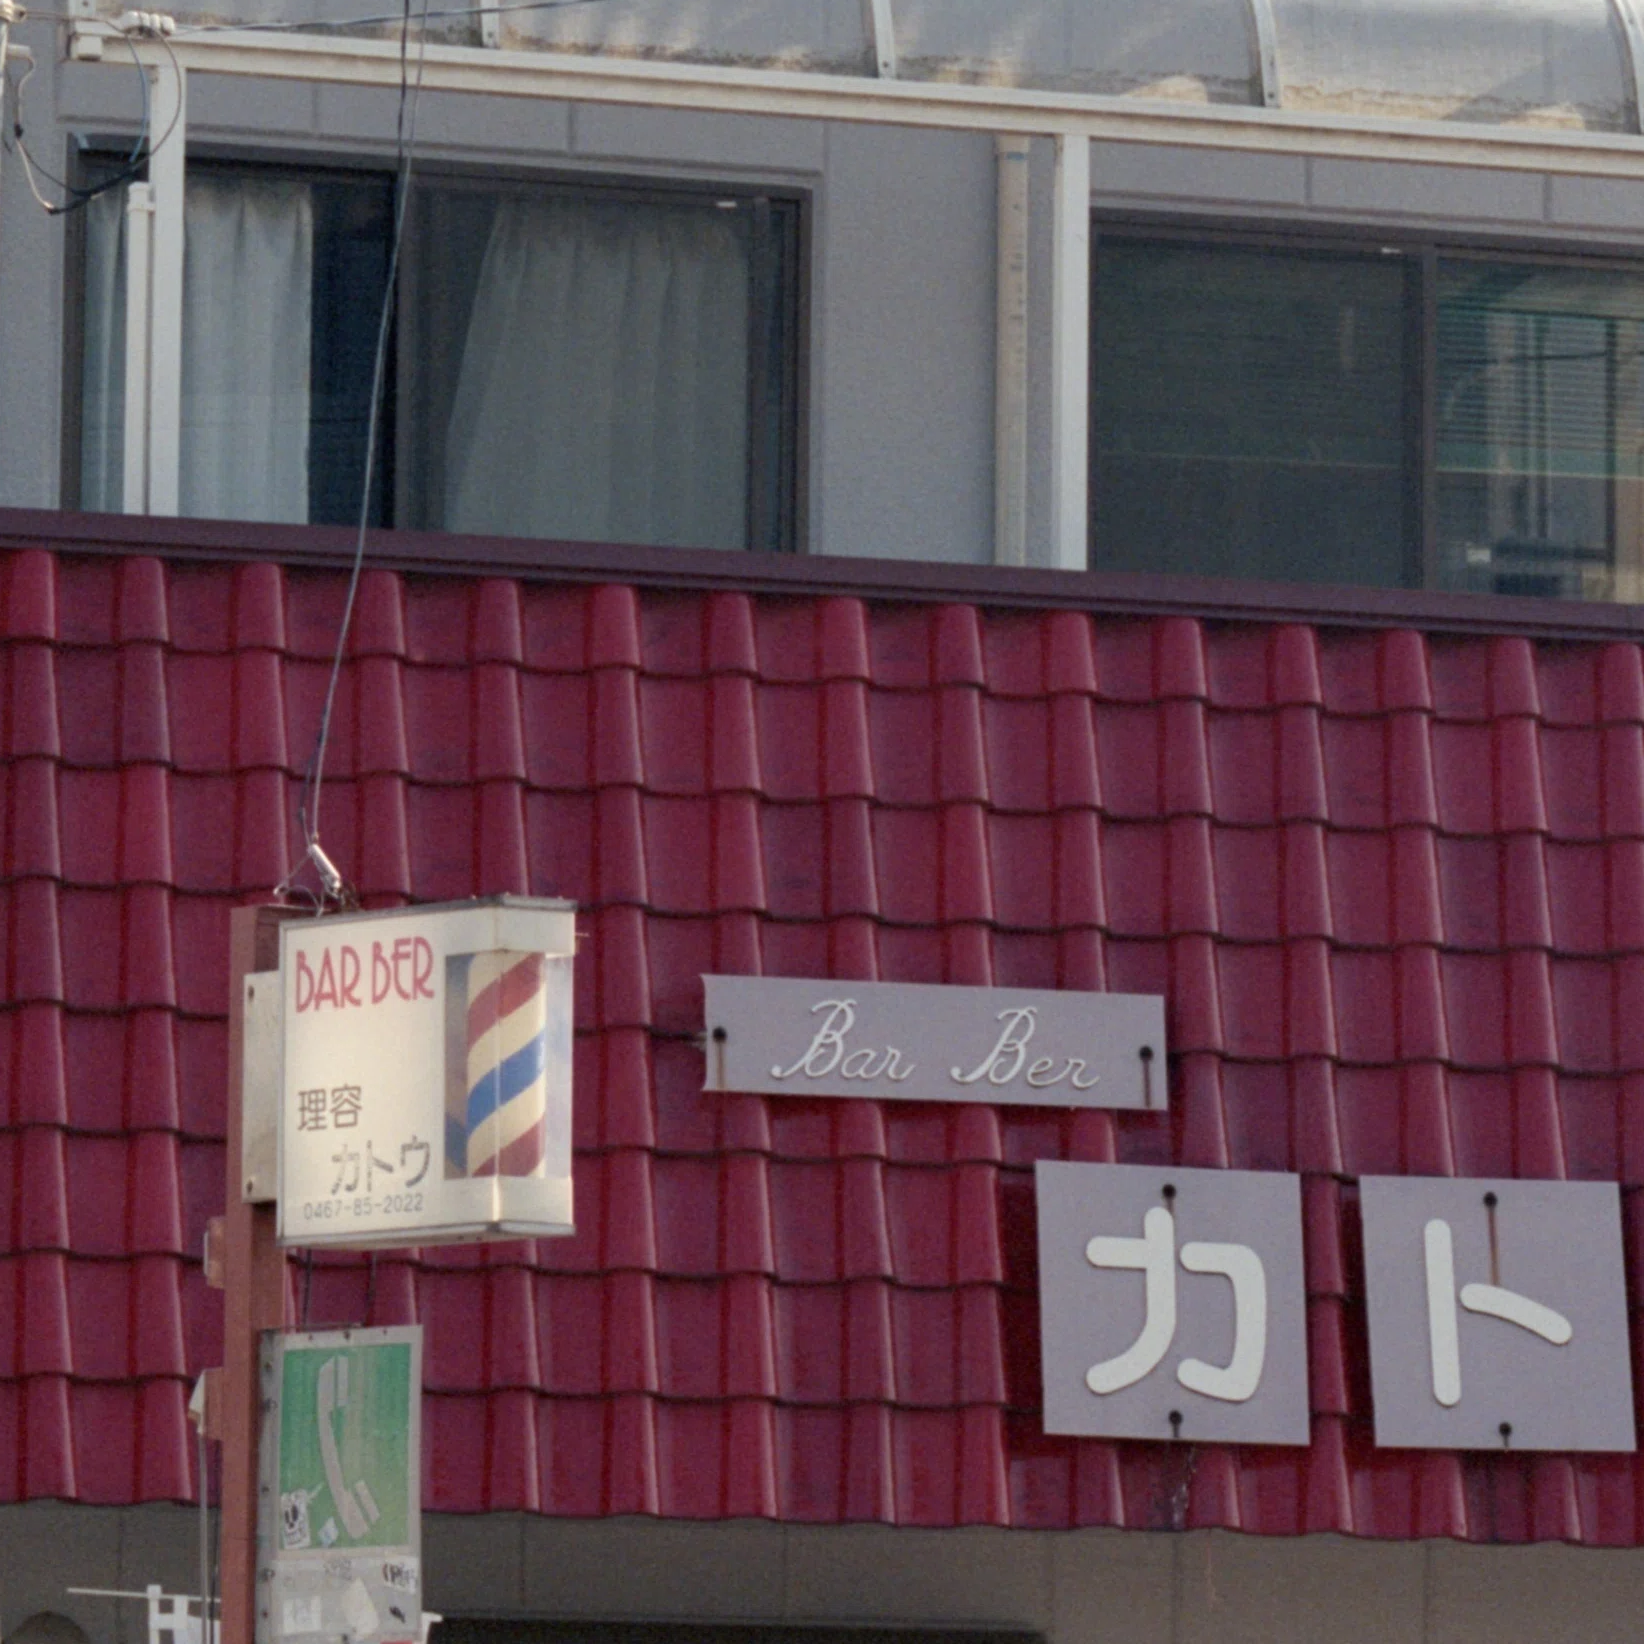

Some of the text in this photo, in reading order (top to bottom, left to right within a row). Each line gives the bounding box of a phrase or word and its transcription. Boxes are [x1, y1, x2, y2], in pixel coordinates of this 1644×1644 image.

[770, 998, 1100, 1090] Bar Ber
[297, 1083, 362, 1132] 理容
[330, 1134, 431, 1196] カトウ
[303, 1192, 425, 1221] 0467-85-2022
